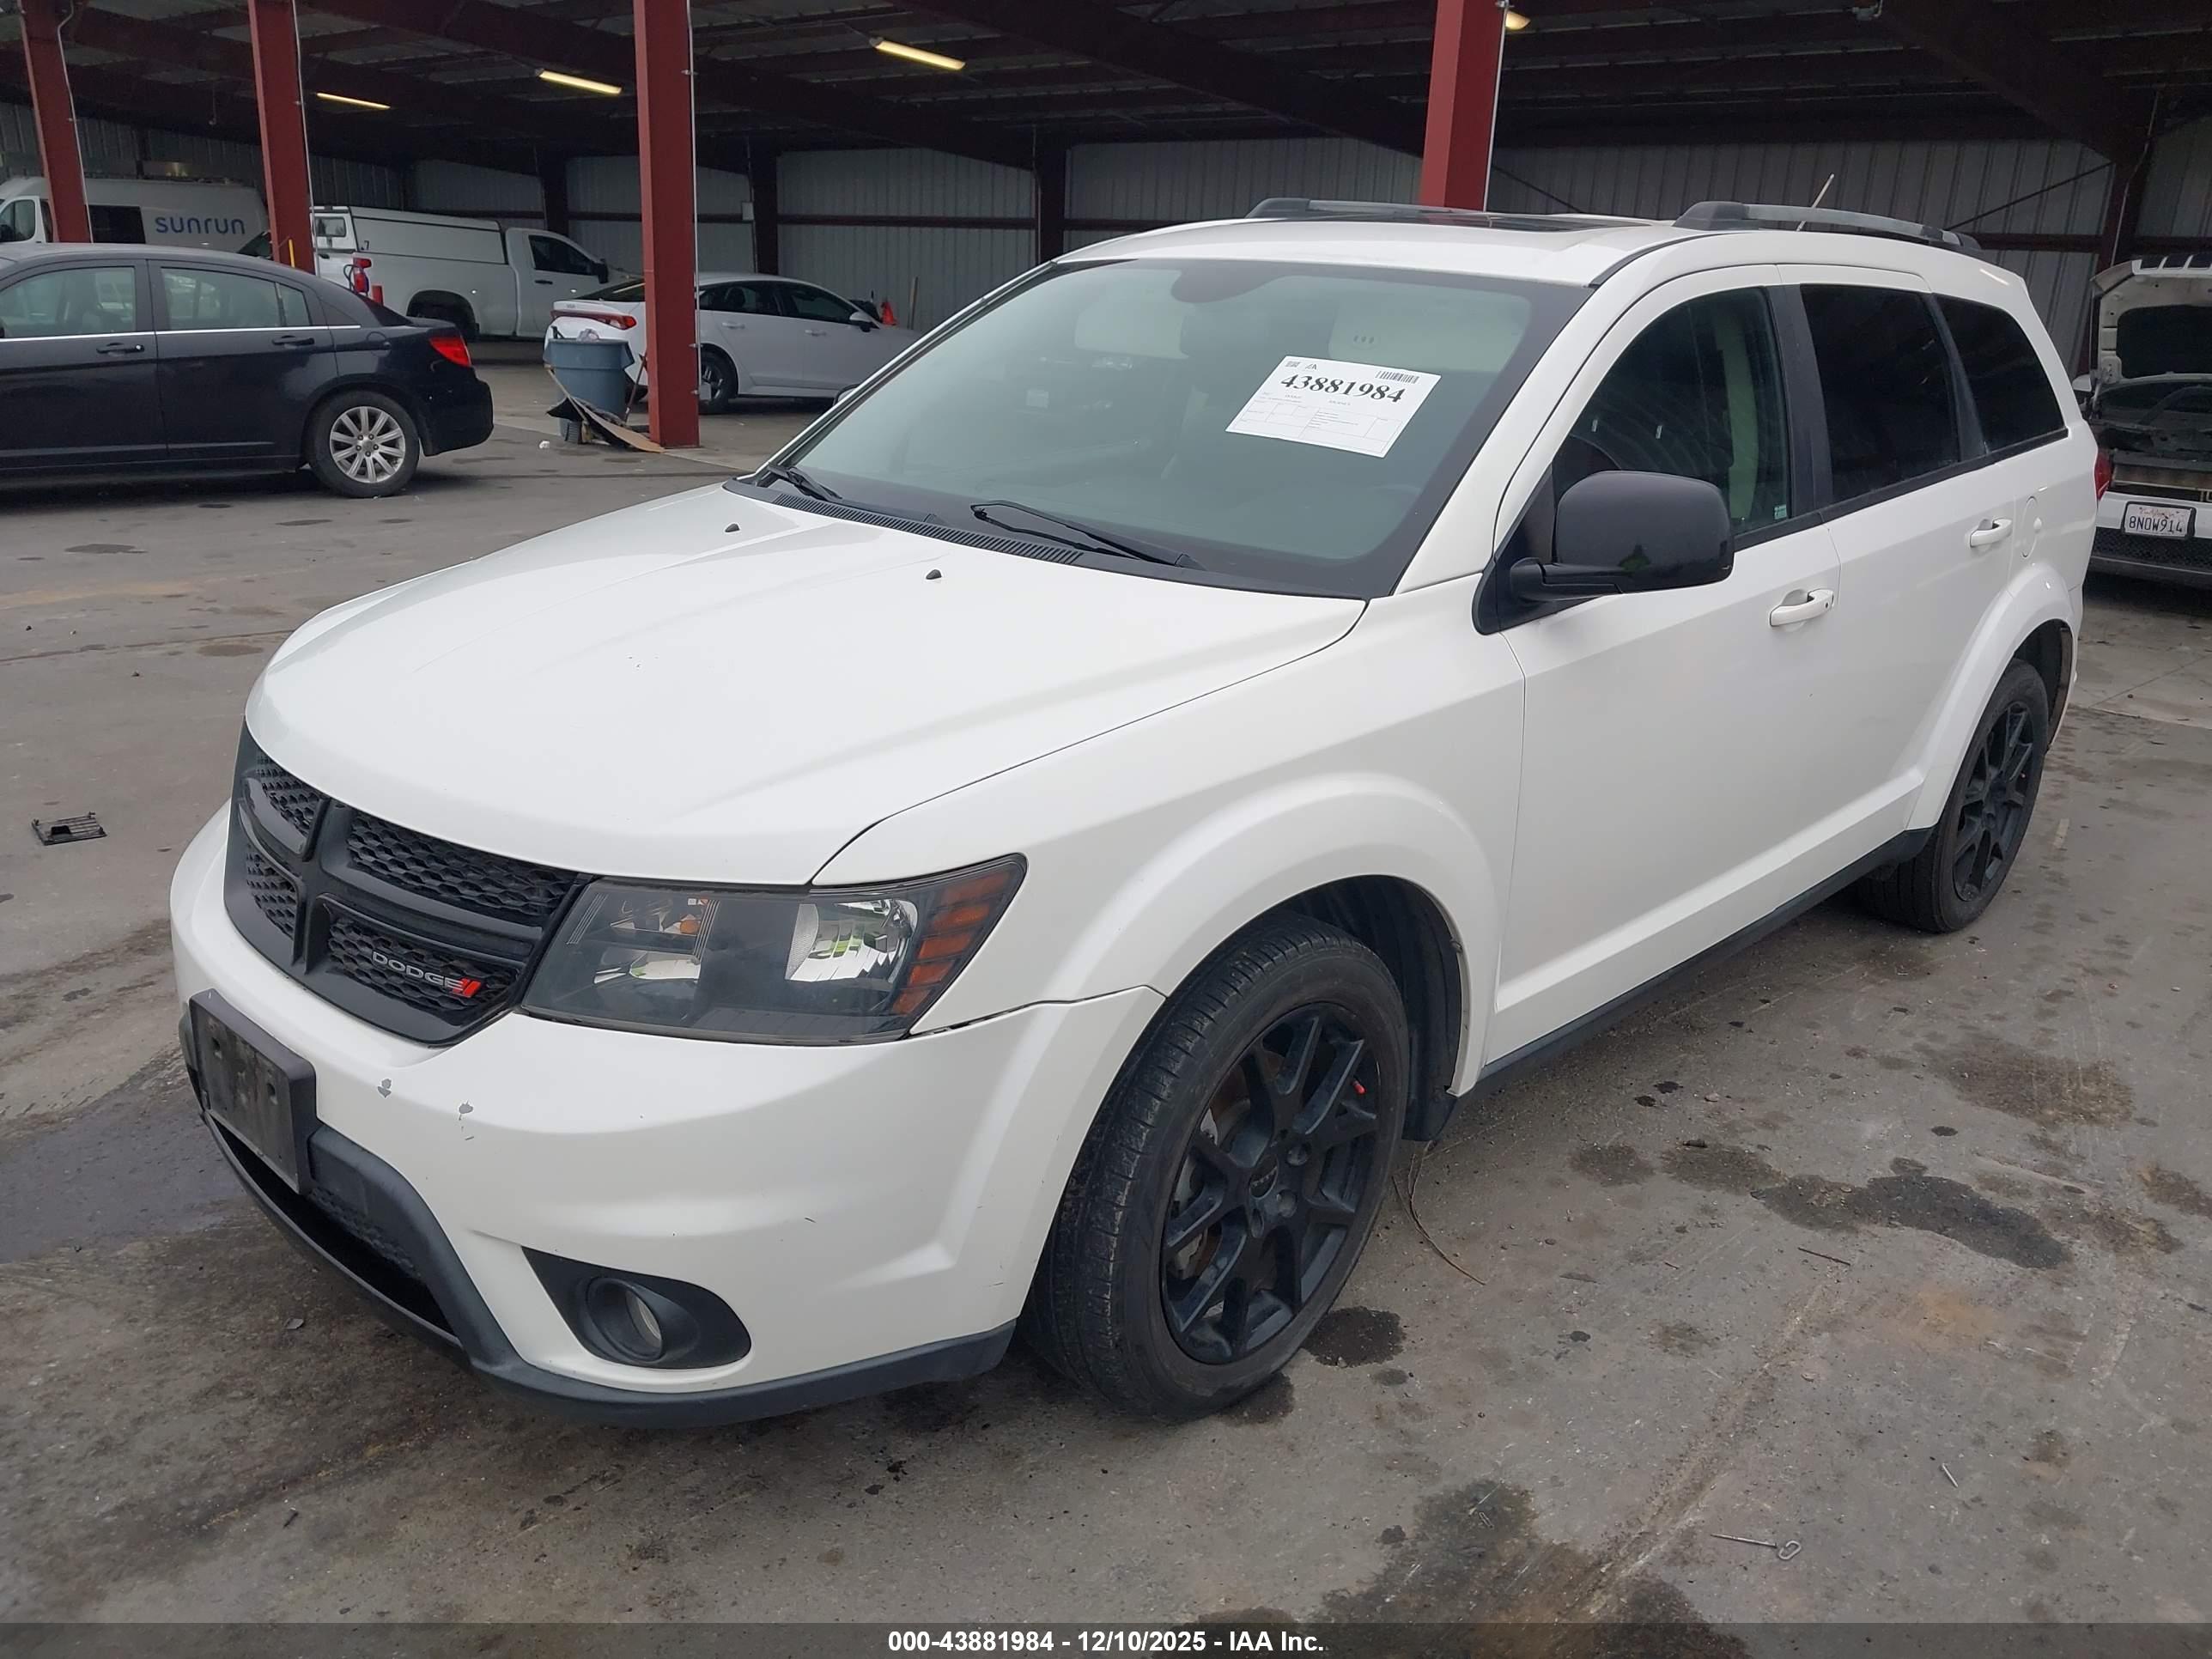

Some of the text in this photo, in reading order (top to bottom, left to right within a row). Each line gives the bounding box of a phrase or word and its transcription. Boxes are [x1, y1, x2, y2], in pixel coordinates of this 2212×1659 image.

[155, 216, 246, 235] sunrun
[1279, 374, 1407, 404] 43881984
[372, 951, 464, 992] DODGE
